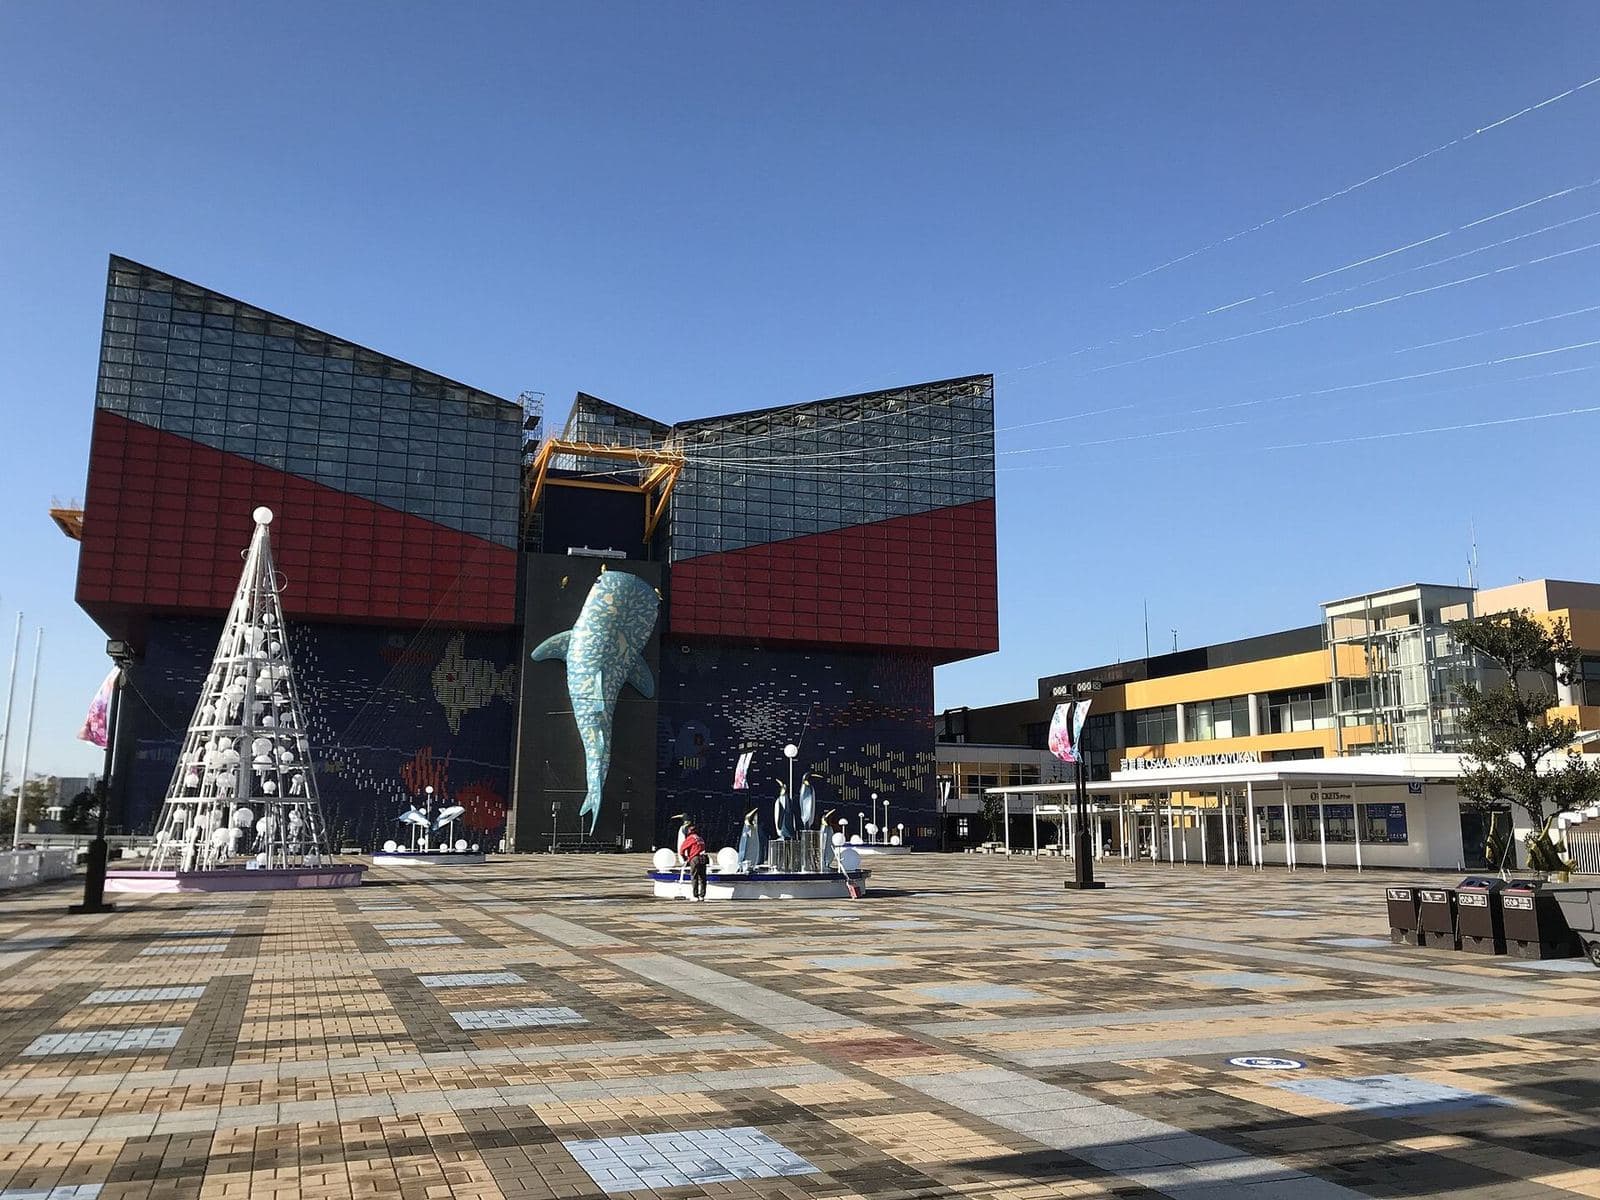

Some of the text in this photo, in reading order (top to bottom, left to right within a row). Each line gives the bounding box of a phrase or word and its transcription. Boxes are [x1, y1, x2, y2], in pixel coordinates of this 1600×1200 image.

[1146, 757, 1170, 770] OSAKA
[1172, 754, 1212, 768] AQUARIUM
[1214, 751, 1257, 764] KAIYUKAN
[1316, 792, 1339, 800] TCKETS
